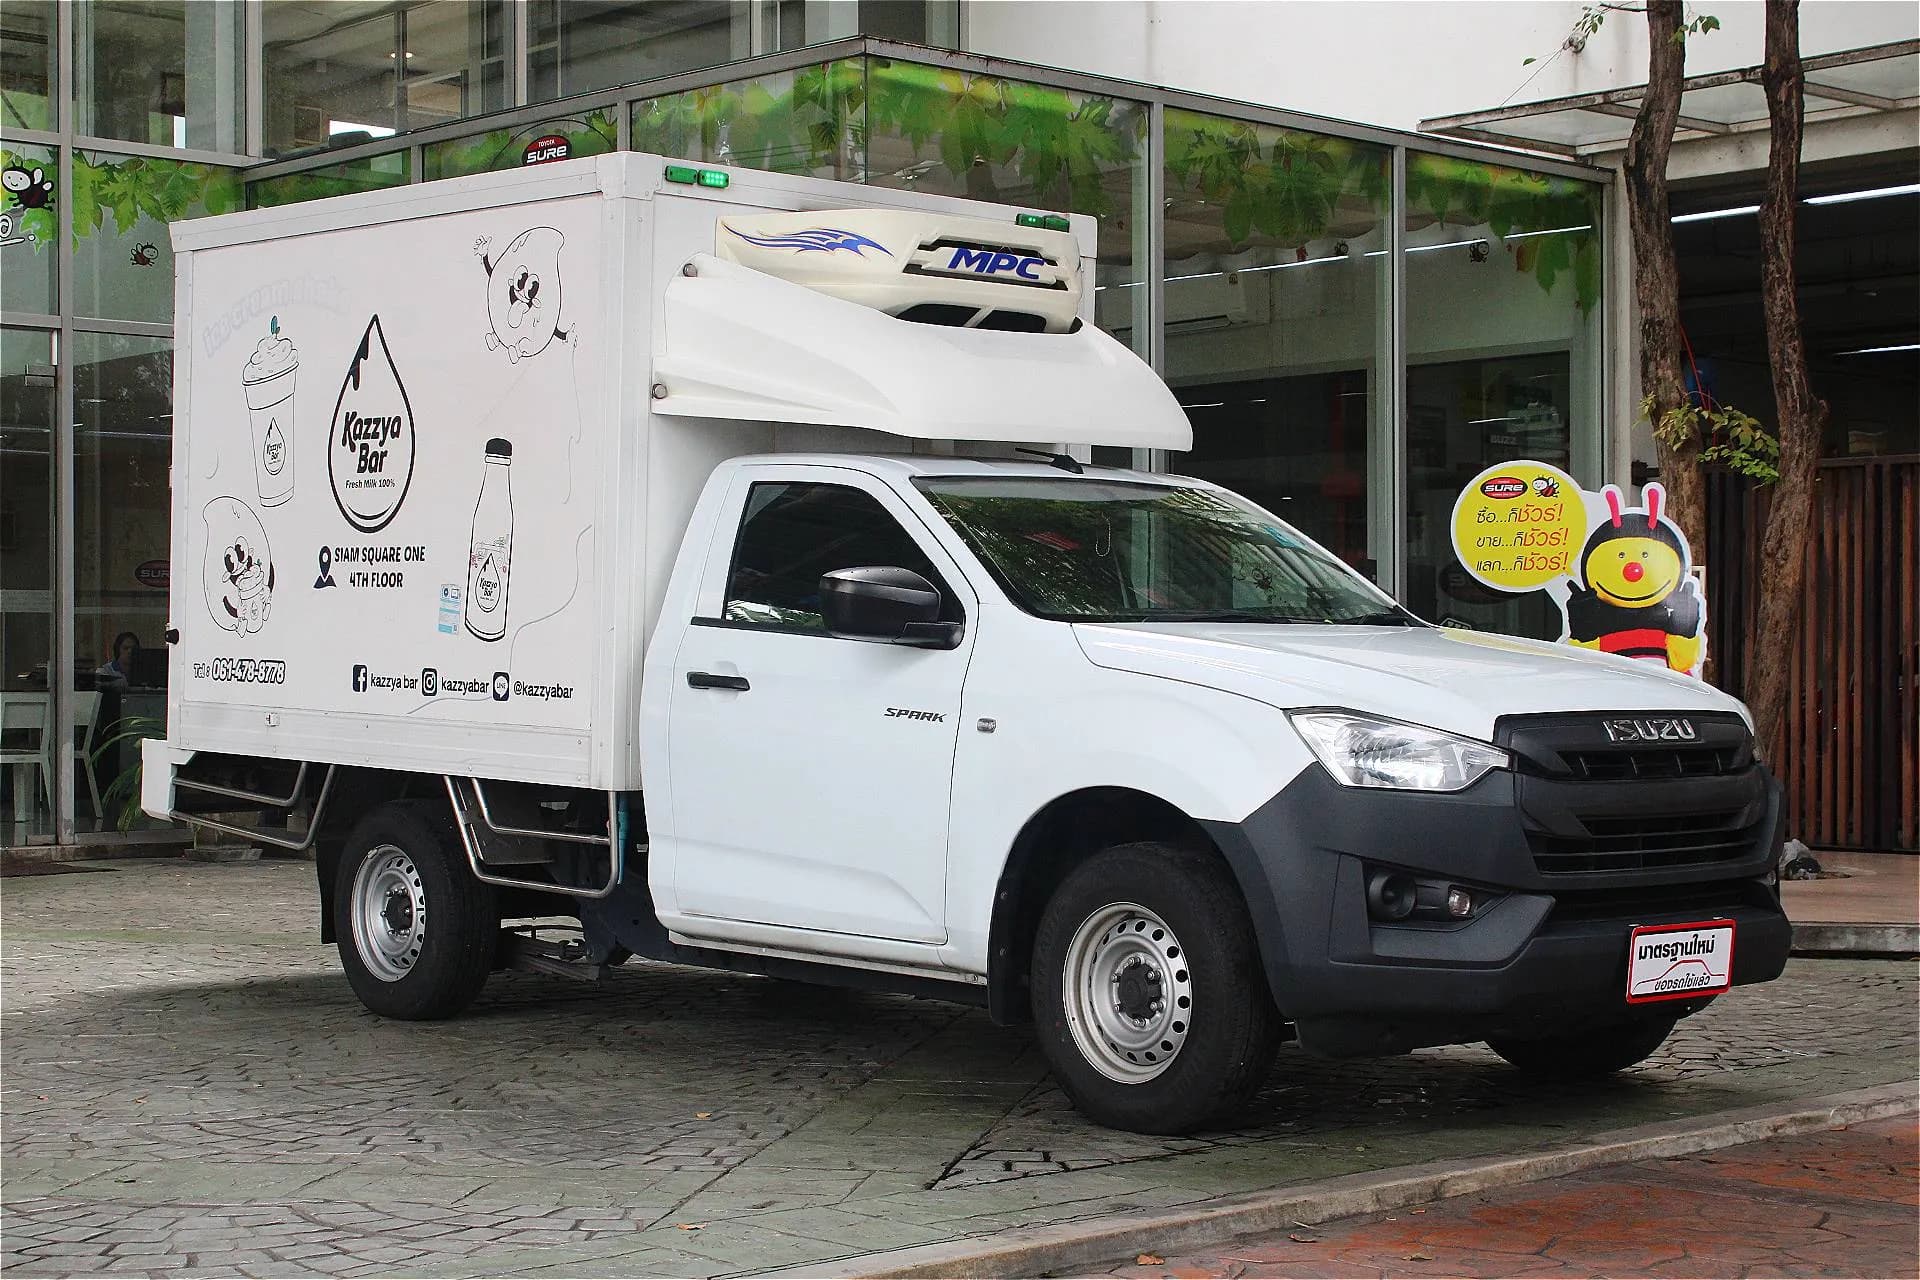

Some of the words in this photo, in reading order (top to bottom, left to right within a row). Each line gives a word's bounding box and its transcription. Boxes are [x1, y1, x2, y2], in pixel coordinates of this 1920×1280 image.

[526, 145, 567, 164] SURE
[947, 247, 1045, 280] MPC
[341, 411, 402, 453] Kazzya
[357, 442, 388, 474] Bar
[345, 479, 362, 489] Fresh
[363, 479, 377, 489] Milk
[378, 478, 396, 488] 100%
[1485, 484, 1523, 492] SURE
[334, 546, 360, 562] SIAM
[361, 546, 401, 566] SQUARE
[404, 545, 426, 562] ONE
[141, 570, 169, 578] SUR
[349, 572, 369, 588] 4TH
[371, 571, 404, 588] FLOOR
[212, 657, 286, 684] 061-478-8778
[370, 673, 402, 692] kazzya
[403, 674, 418, 690] bar
[441, 677, 490, 696] kazzyabar
[513, 681, 574, 702] @kazzyabar
[884, 707, 947, 723] SPARK
[1602, 719, 1695, 741] ISUZU
[1638, 933, 1715, 962] มาตรฐานใหม่
[1654, 972, 1711, 991] ของรถใช้แล้ว
